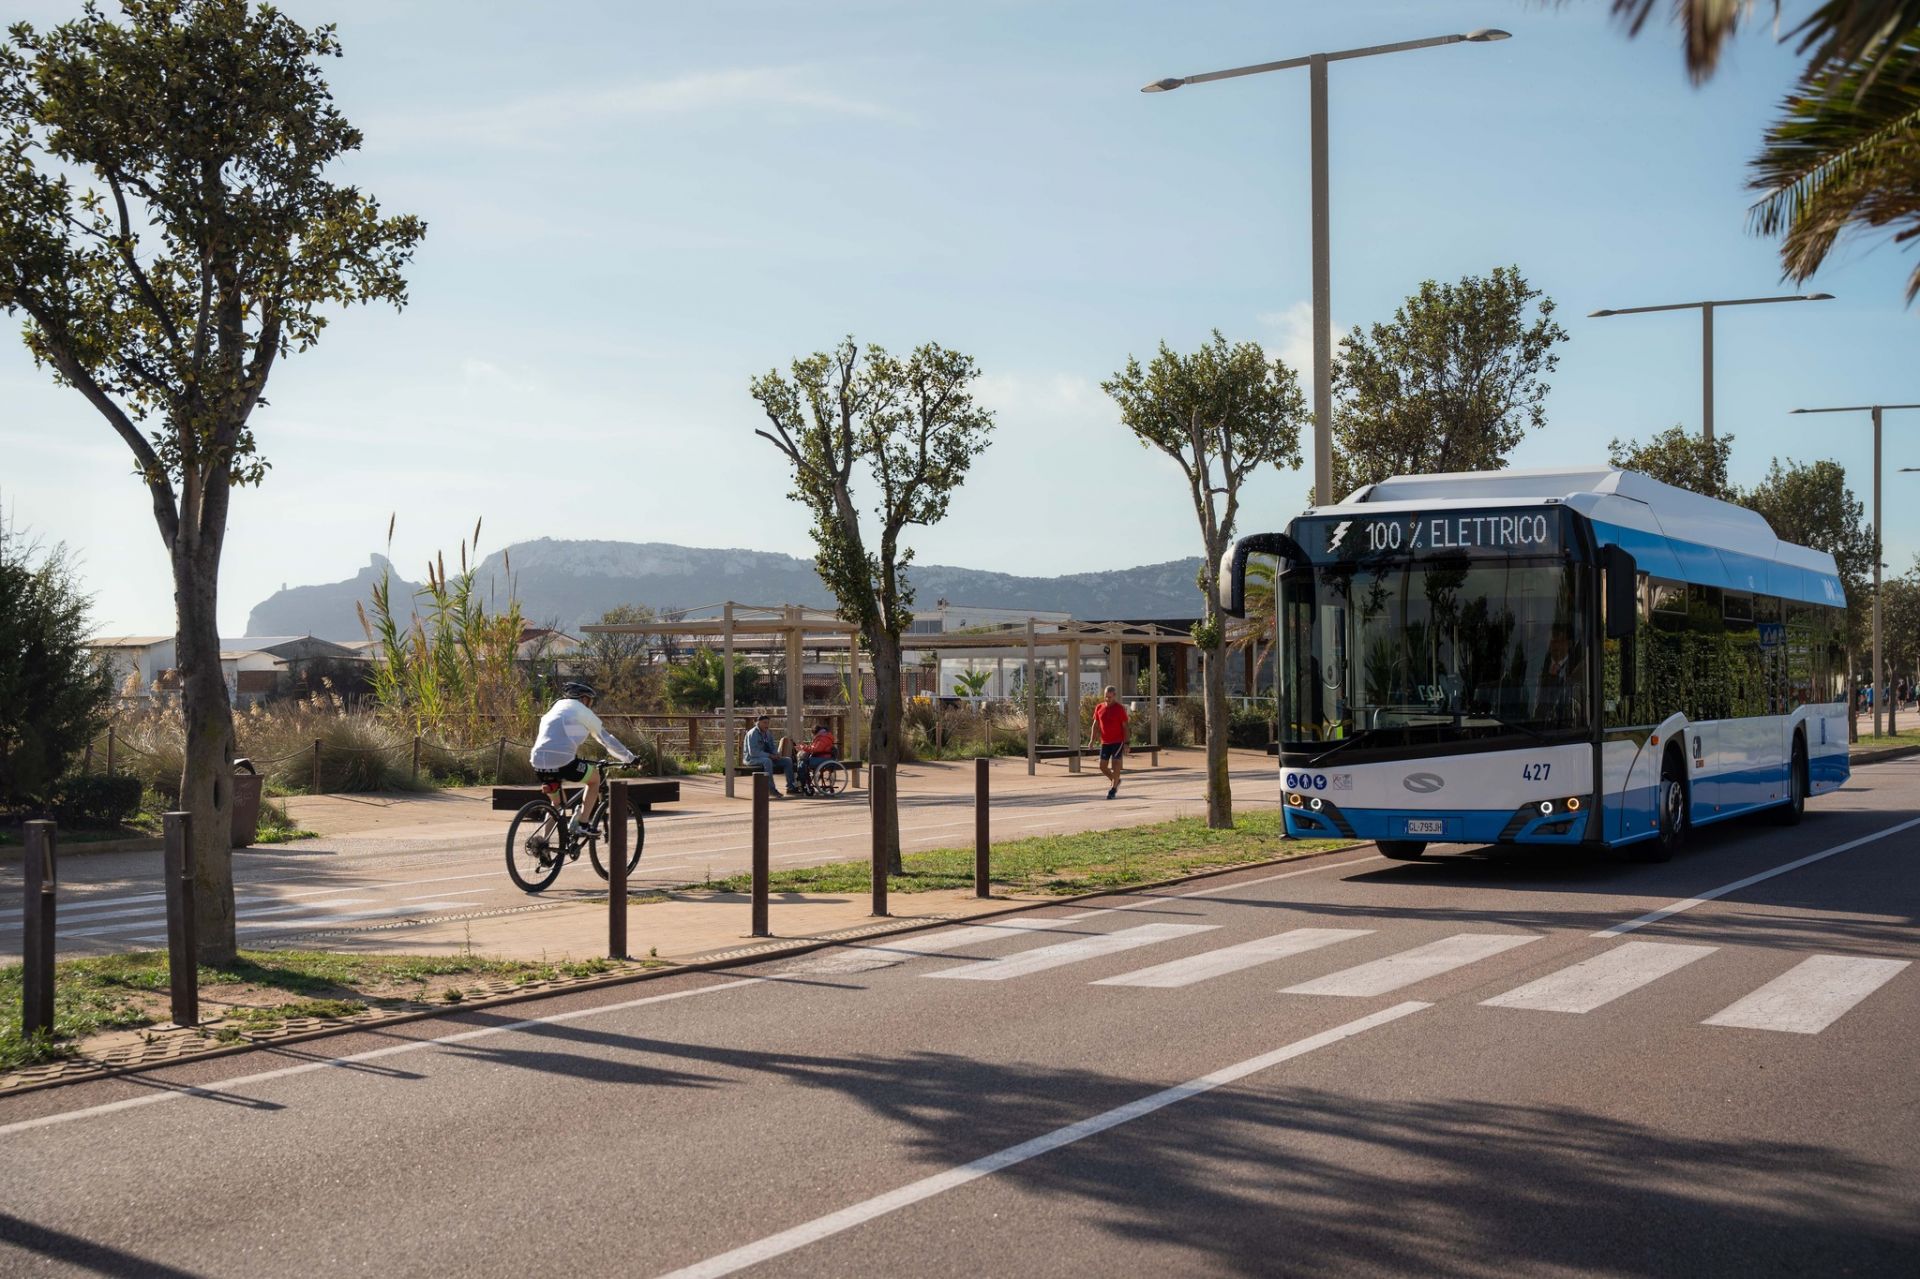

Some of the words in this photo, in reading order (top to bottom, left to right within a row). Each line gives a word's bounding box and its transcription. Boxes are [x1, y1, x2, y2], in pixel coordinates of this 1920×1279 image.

[1365, 521, 1401, 550] 100
[1409, 521, 1423, 549] %
[1431, 515, 1547, 548] ELETTRICO
[1522, 763, 1551, 781] 427
